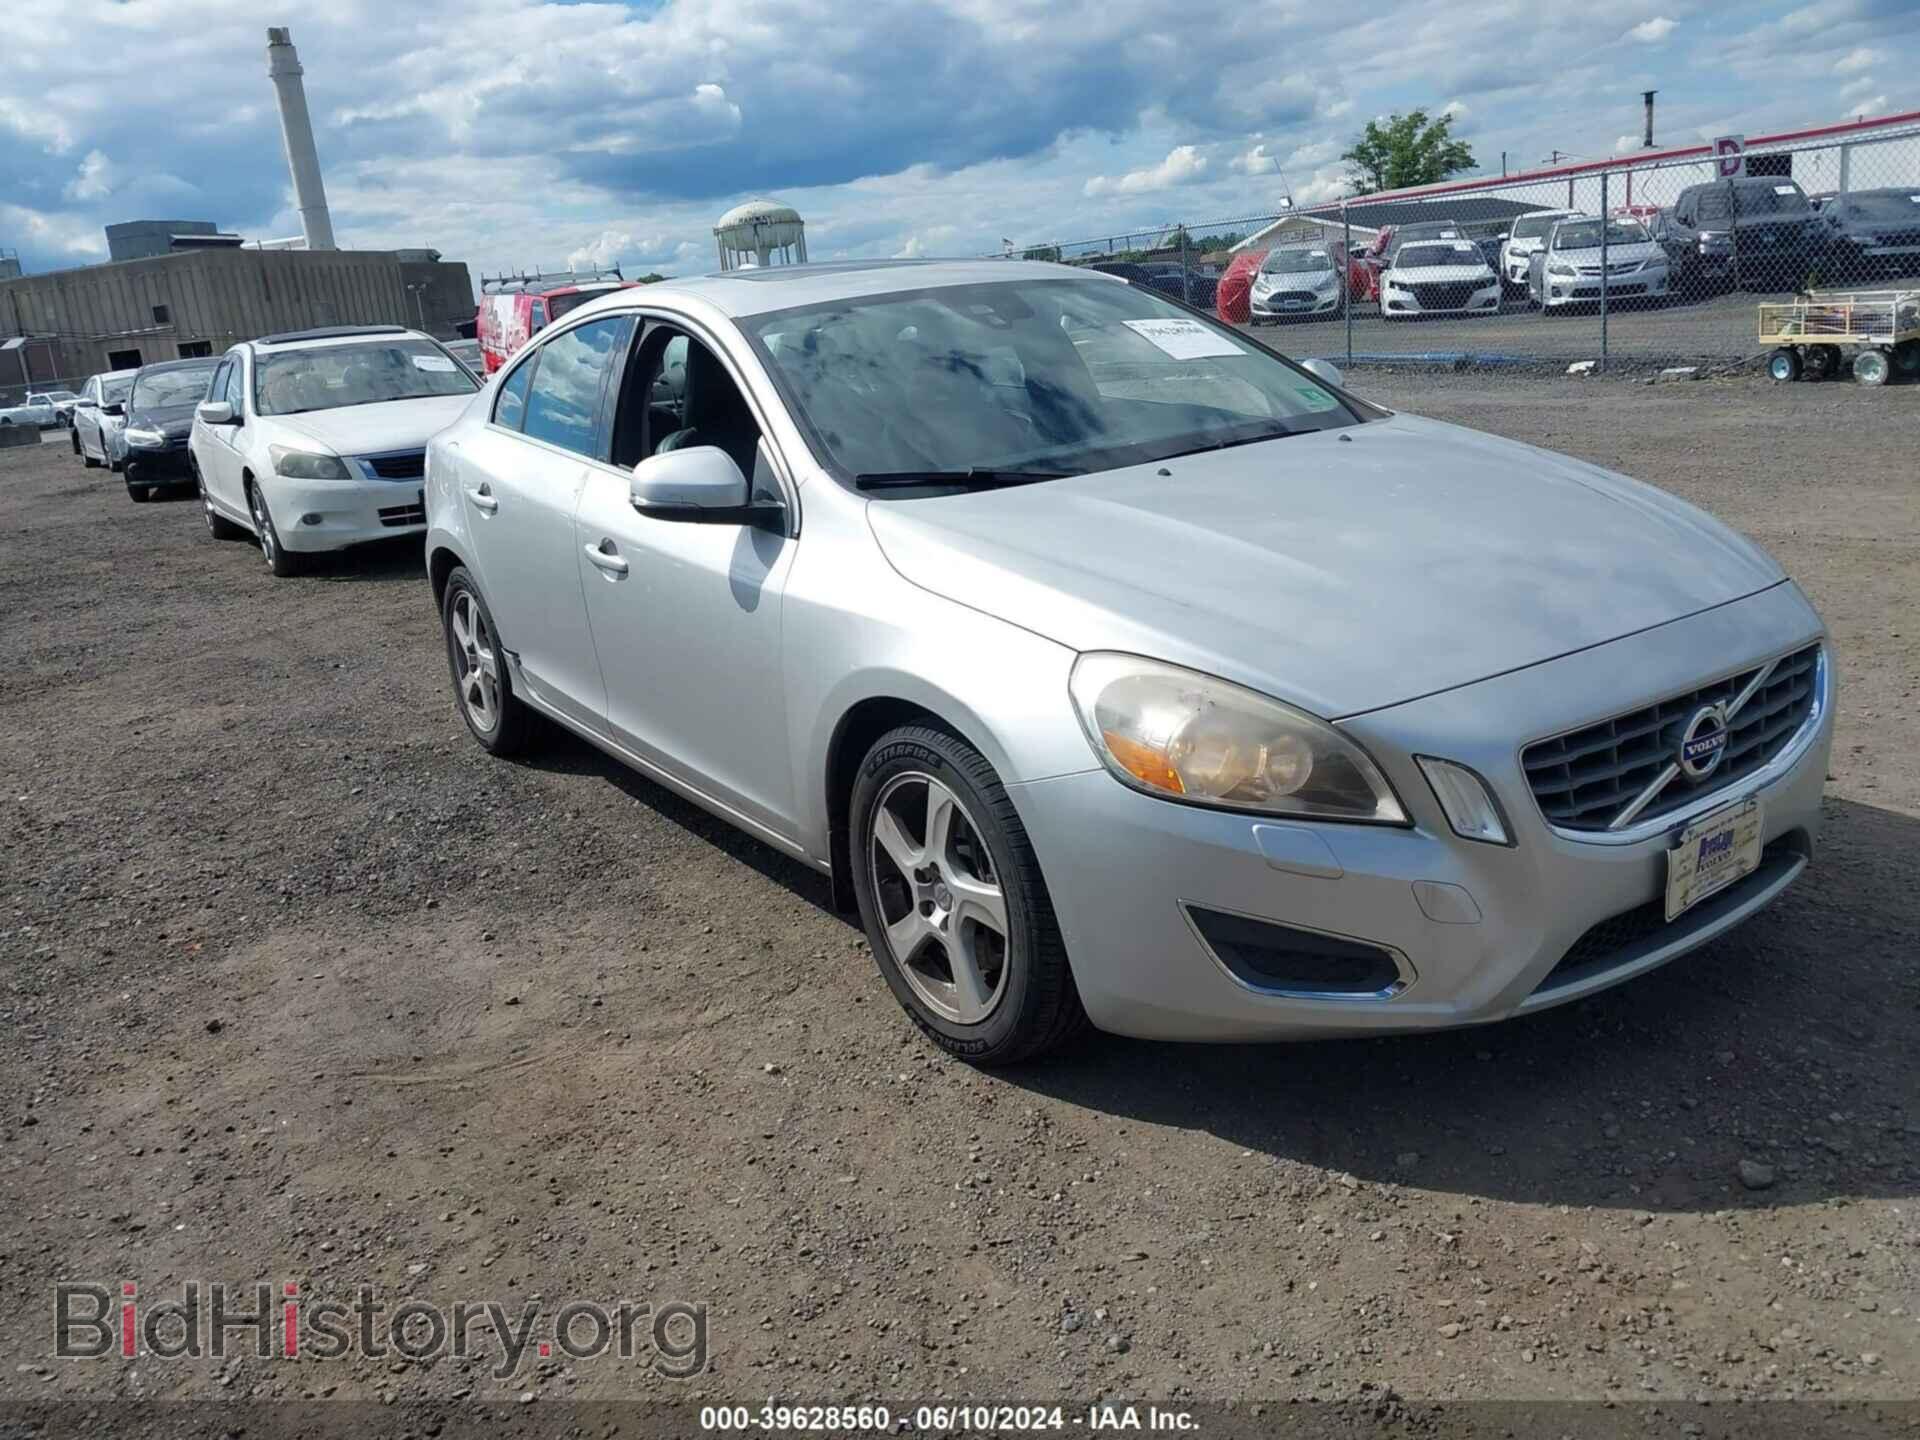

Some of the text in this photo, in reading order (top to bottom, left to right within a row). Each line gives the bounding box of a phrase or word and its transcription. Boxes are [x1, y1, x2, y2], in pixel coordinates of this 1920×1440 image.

[1718, 139, 1741, 176] D
[874, 743, 941, 767] STARFIRE
[1687, 734, 1725, 755] VOLVO
